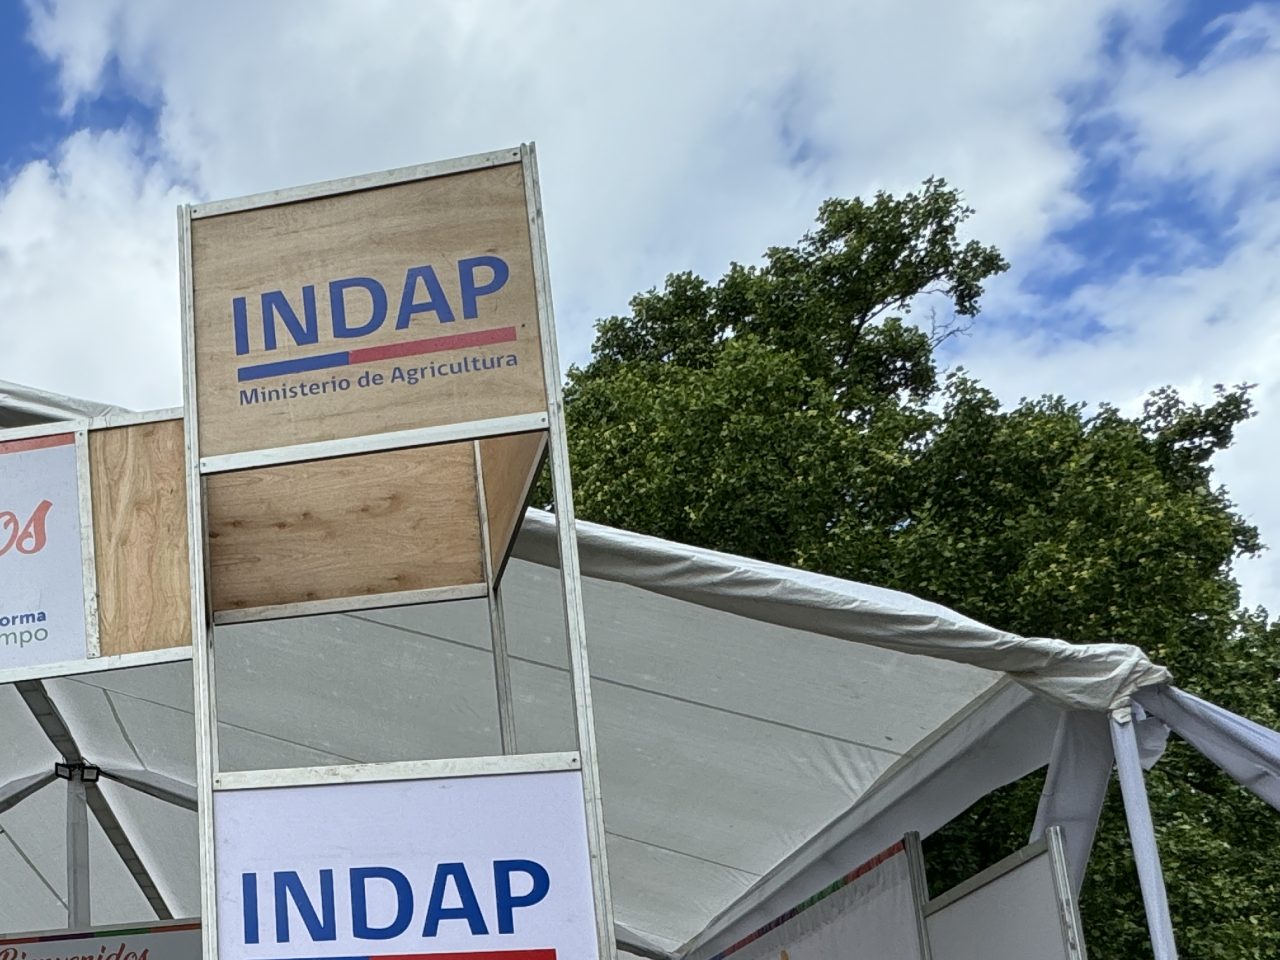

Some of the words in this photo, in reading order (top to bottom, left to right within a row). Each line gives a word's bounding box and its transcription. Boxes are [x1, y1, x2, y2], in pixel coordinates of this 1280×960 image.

[232, 255, 510, 356] INDAP
[239, 376, 351, 405] Ministerio
[357, 370, 384, 389] de
[390, 351, 518, 385] Agricultura
[241, 859, 552, 945] INDAP
